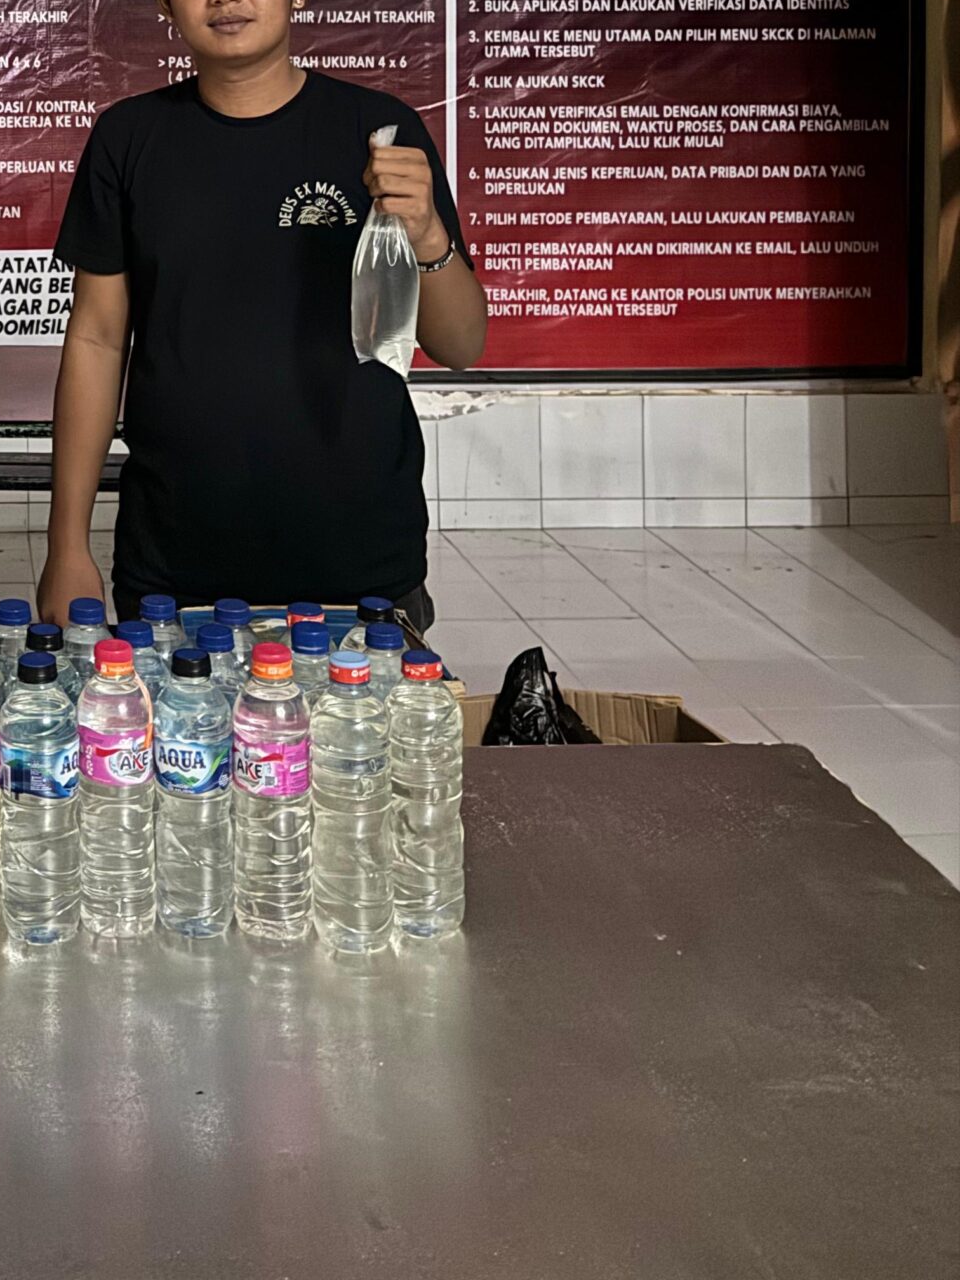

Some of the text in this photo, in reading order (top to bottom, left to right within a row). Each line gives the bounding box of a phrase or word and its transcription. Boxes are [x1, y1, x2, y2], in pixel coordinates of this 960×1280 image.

[469, 0, 479, 12] 2.
[485, 0, 520, 12] BUKA
[583, 0, 610, 11] DAN
[615, 0, 674, 11] LAKUKAN
[279, 181, 357, 227] DEUS EX MACHINA
[120, 750, 149, 772] AKE
[158, 745, 206, 772] AQUA
[237, 759, 263, 779] AKE
